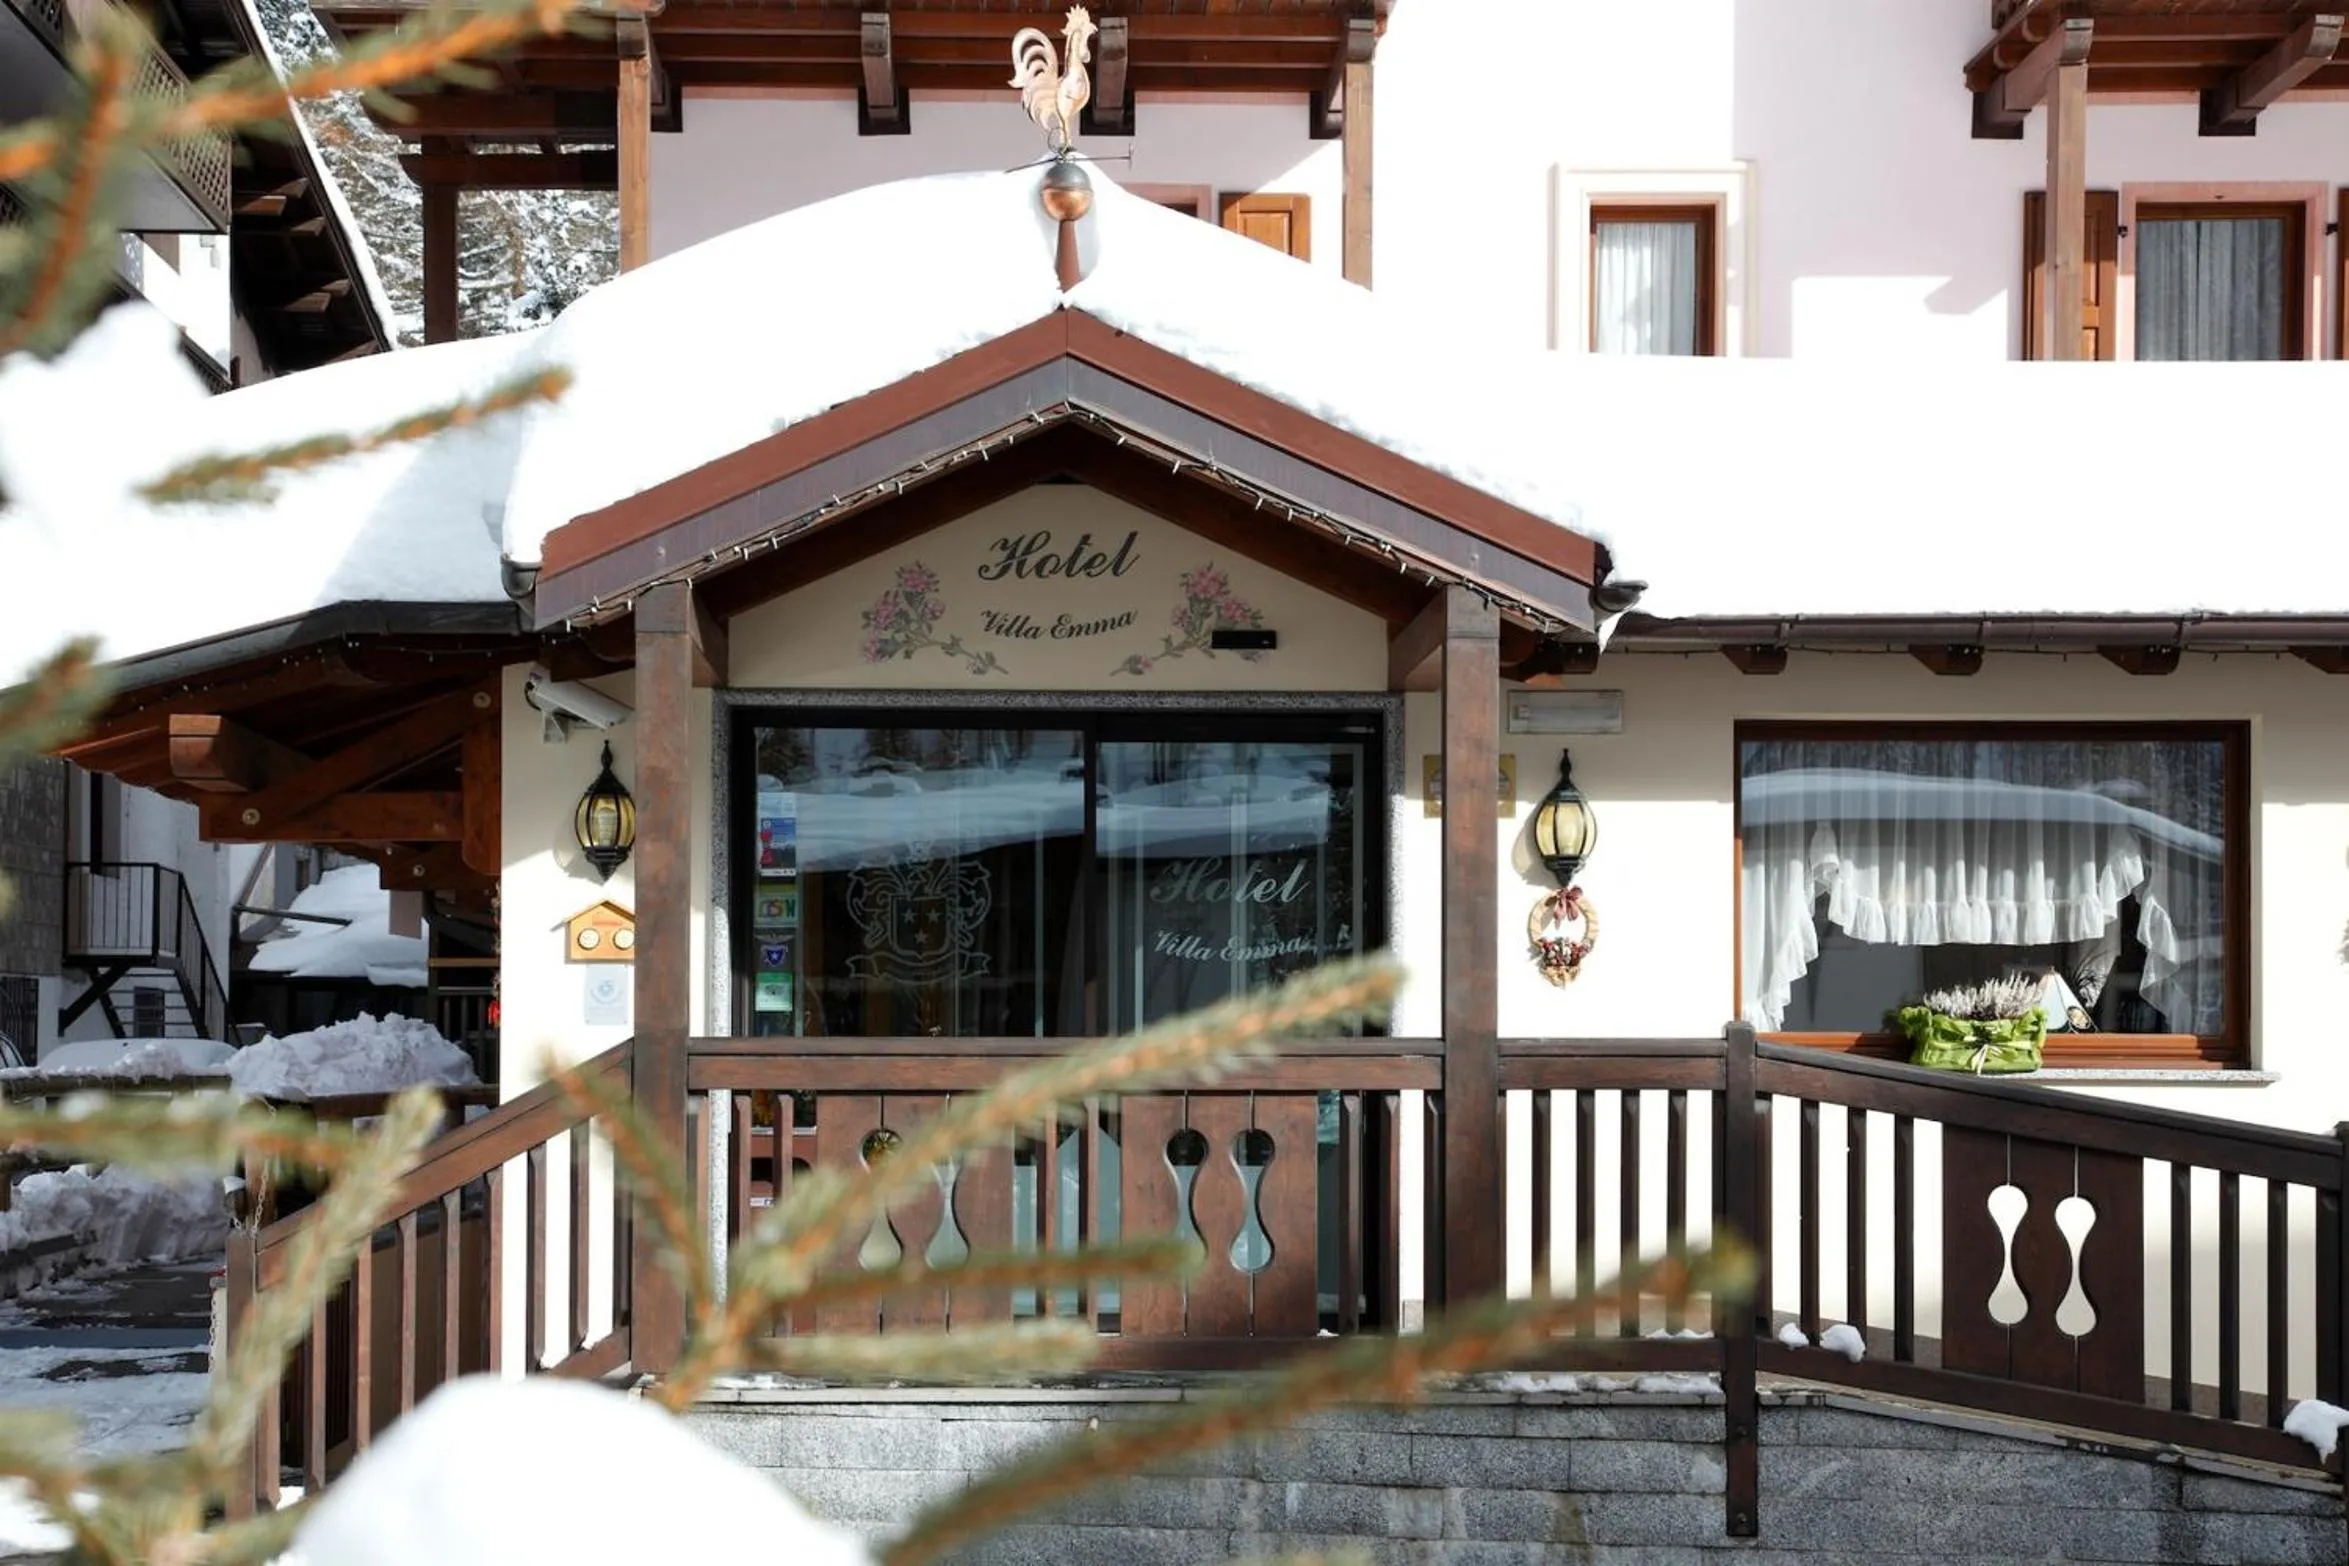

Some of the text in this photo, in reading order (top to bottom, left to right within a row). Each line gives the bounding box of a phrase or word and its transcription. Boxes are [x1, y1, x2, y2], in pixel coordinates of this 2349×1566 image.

[977, 530, 1141, 581] Hotel
[980, 609, 1139, 640] Villa Emma
[1150, 856, 1312, 904] Hotel
[1154, 928, 1215, 961] Villa
